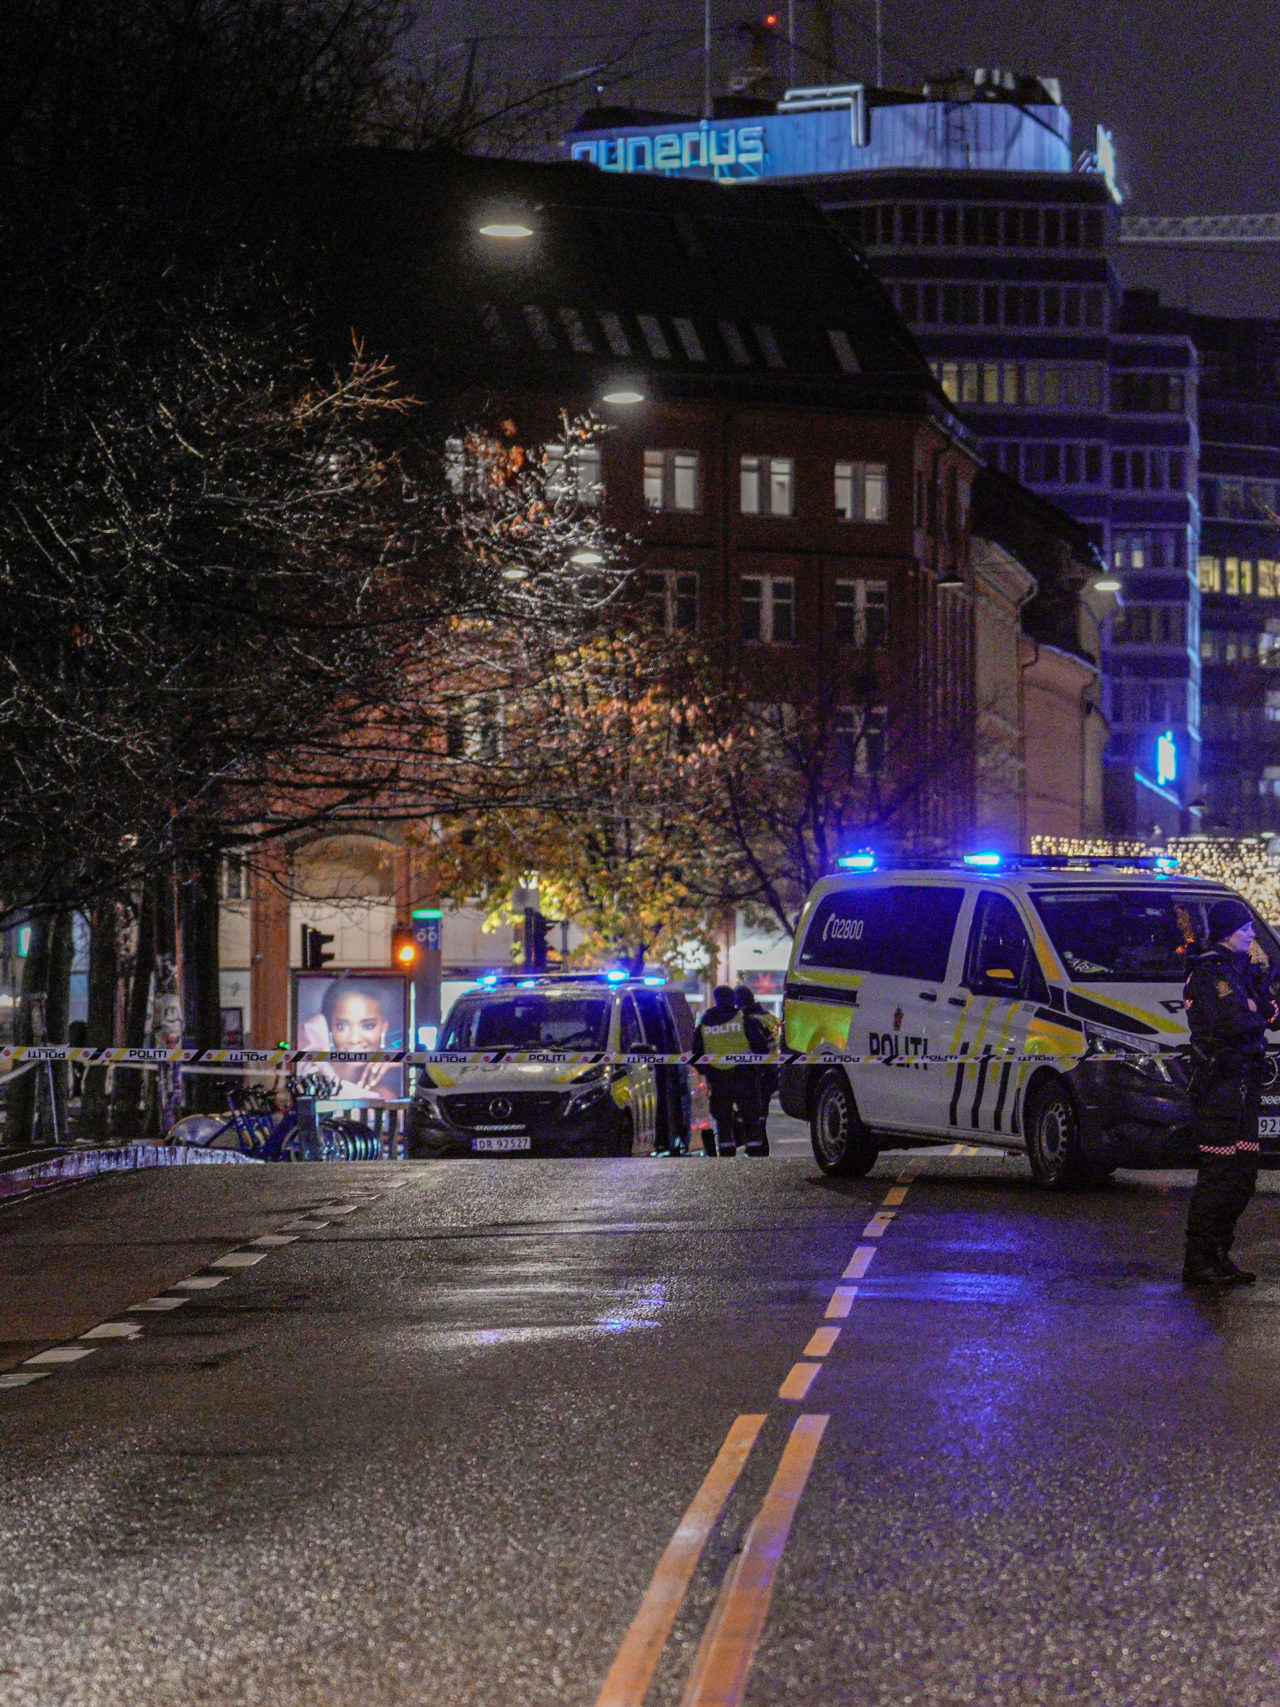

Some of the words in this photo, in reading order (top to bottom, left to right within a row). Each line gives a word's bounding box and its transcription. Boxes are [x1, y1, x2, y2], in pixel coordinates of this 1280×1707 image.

[831, 919, 864, 940] 02800
[704, 1022, 742, 1036] POLITI
[27, 1051, 66, 1059] POLITI
[129, 1050, 167, 1059] POLITI
[229, 1052, 267, 1061] POLITI
[329, 1052, 368, 1060] POLITI
[429, 1055, 467, 1063] POLITI
[528, 1053, 566, 1062] POLITI
[626, 1056, 664, 1064] POLITI
[479, 1139, 493, 1149] DR
[496, 1138, 528, 1148] 92527
